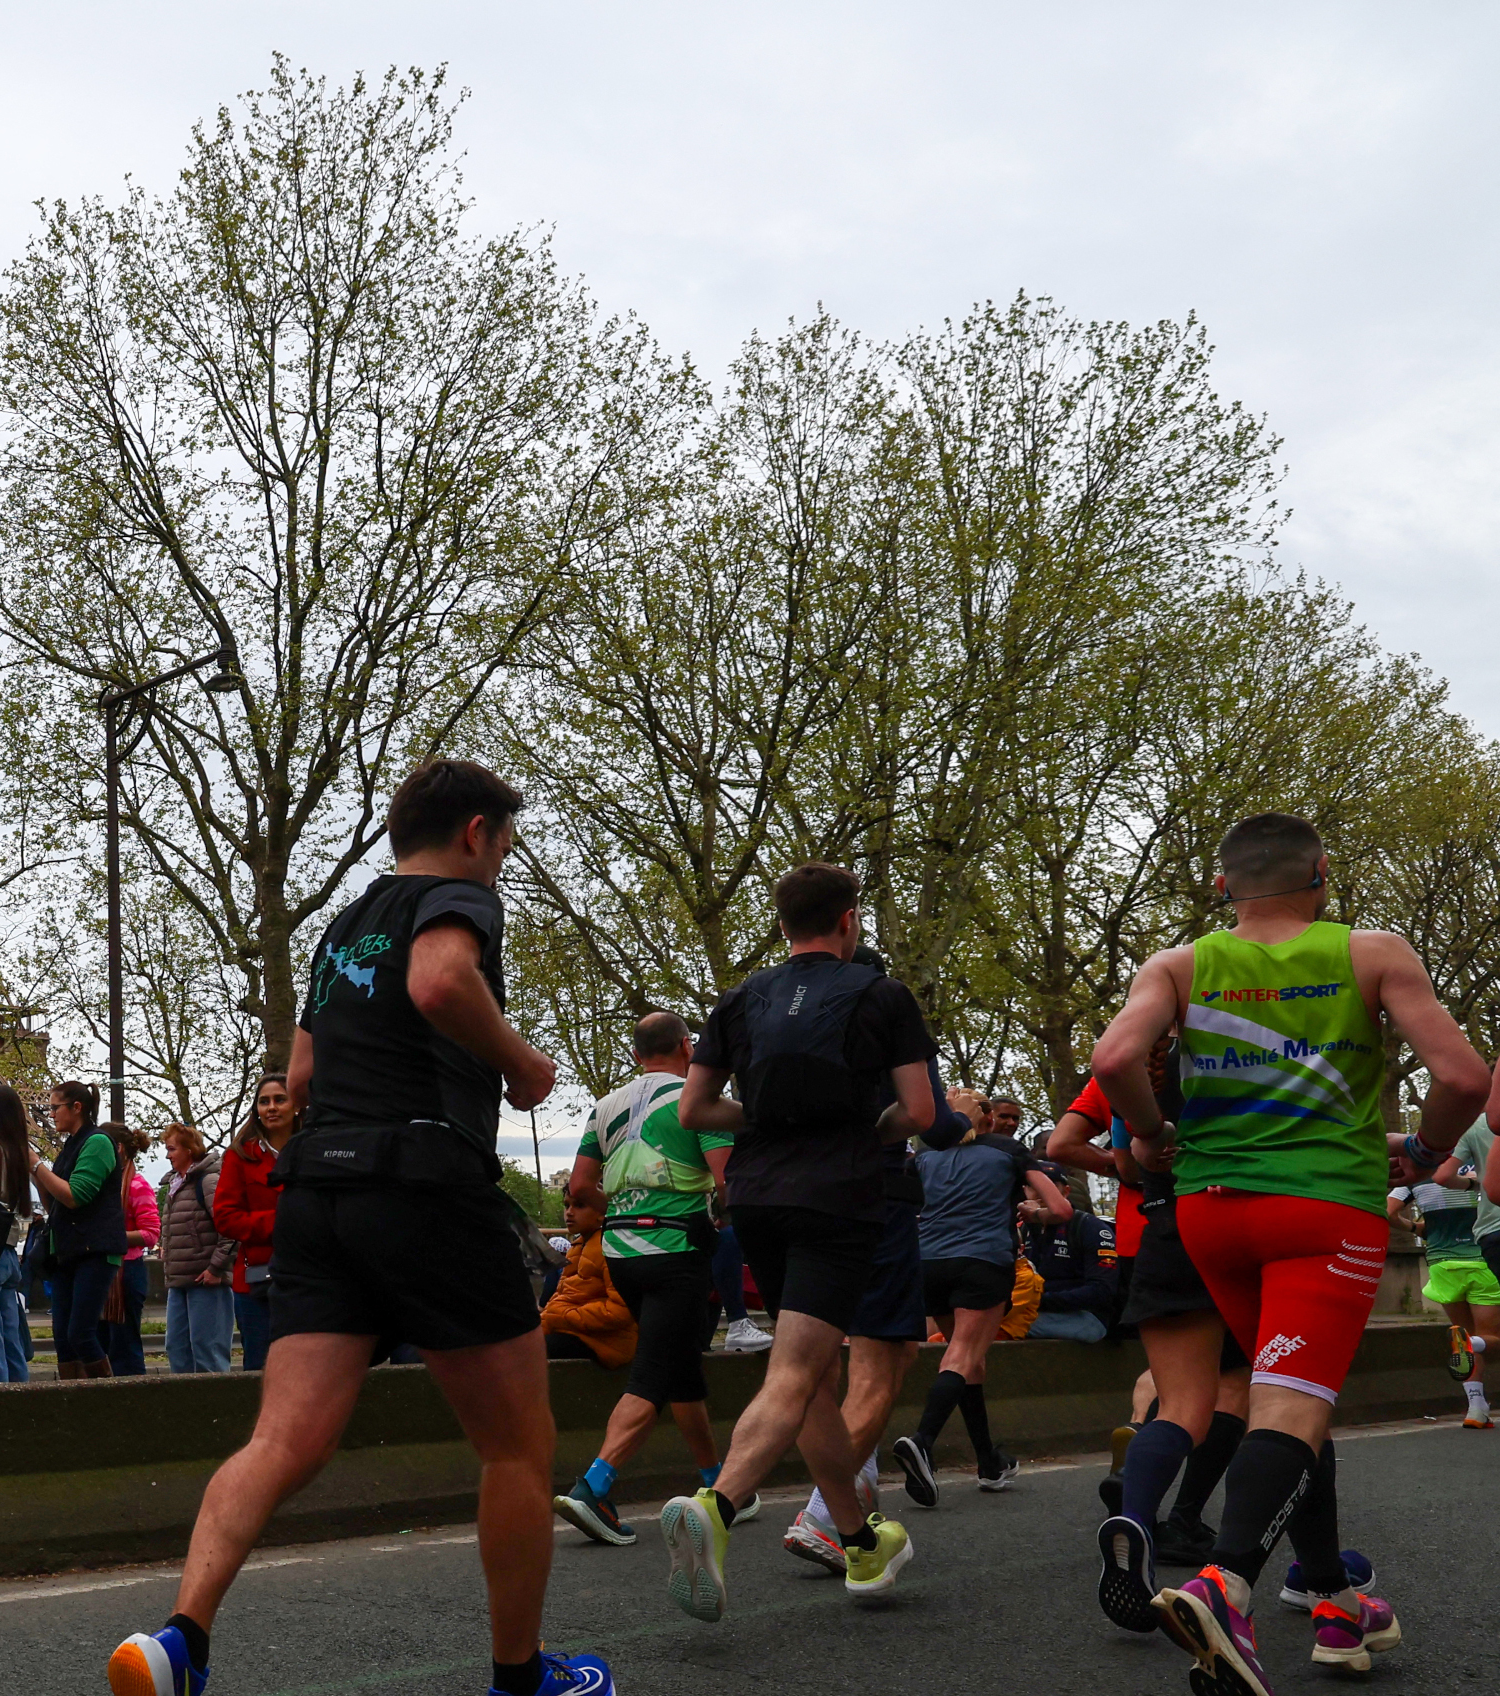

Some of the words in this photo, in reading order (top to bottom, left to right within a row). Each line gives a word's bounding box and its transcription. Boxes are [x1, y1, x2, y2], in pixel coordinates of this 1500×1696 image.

[788, 984, 808, 1016] EVADICT
[1223, 982, 1341, 1002] INTERSPORT
[1221, 1047, 1278, 1070] Athlé
[1284, 1038, 1372, 1060] Marathon
[323, 1150, 356, 1159] KIPRUN
[1253, 1333, 1290, 1369] OMPRE
[1260, 1468, 1311, 1552] BOOSTER
